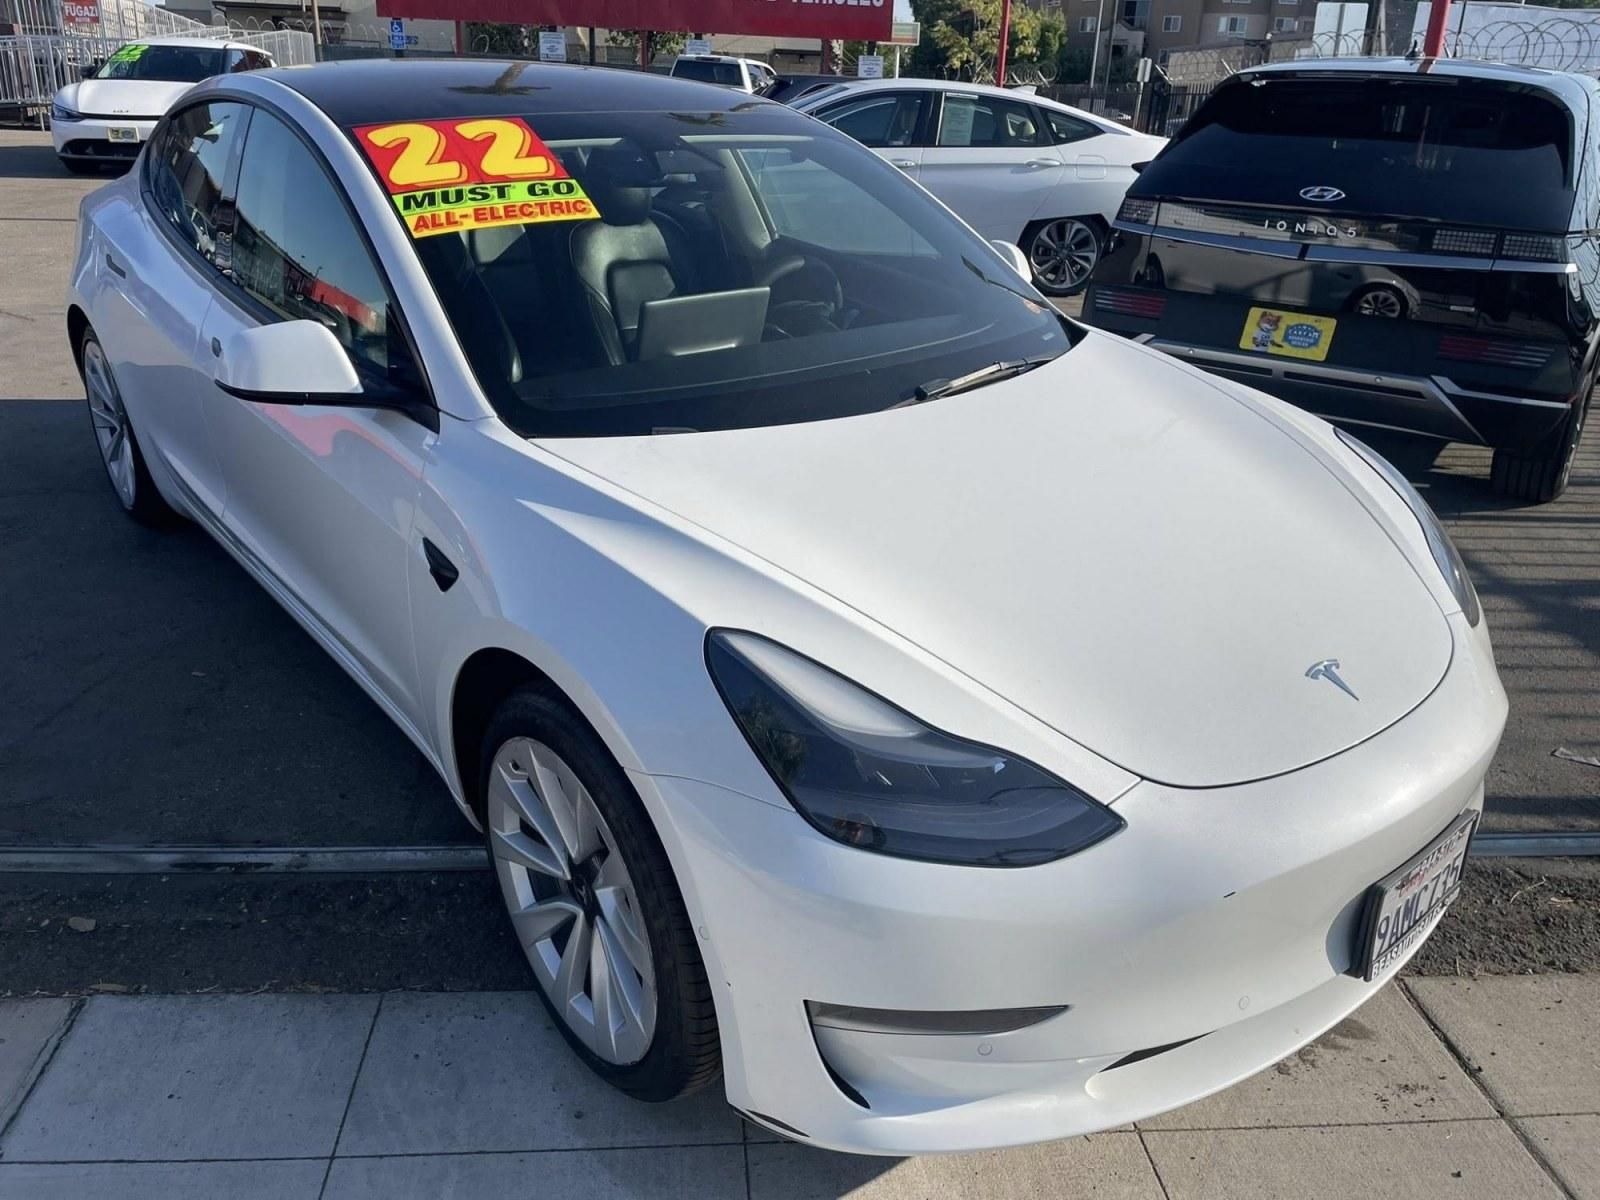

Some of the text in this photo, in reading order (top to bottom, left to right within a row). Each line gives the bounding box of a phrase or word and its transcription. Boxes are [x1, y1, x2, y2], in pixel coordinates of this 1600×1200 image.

[64, 5, 98, 16] FUGAZI
[367, 119, 555, 186] 22
[402, 181, 577, 211] MUST GO
[413, 200, 591, 232] ALL-ELECTRIC
[1264, 219, 1358, 239] IONIQ 5
